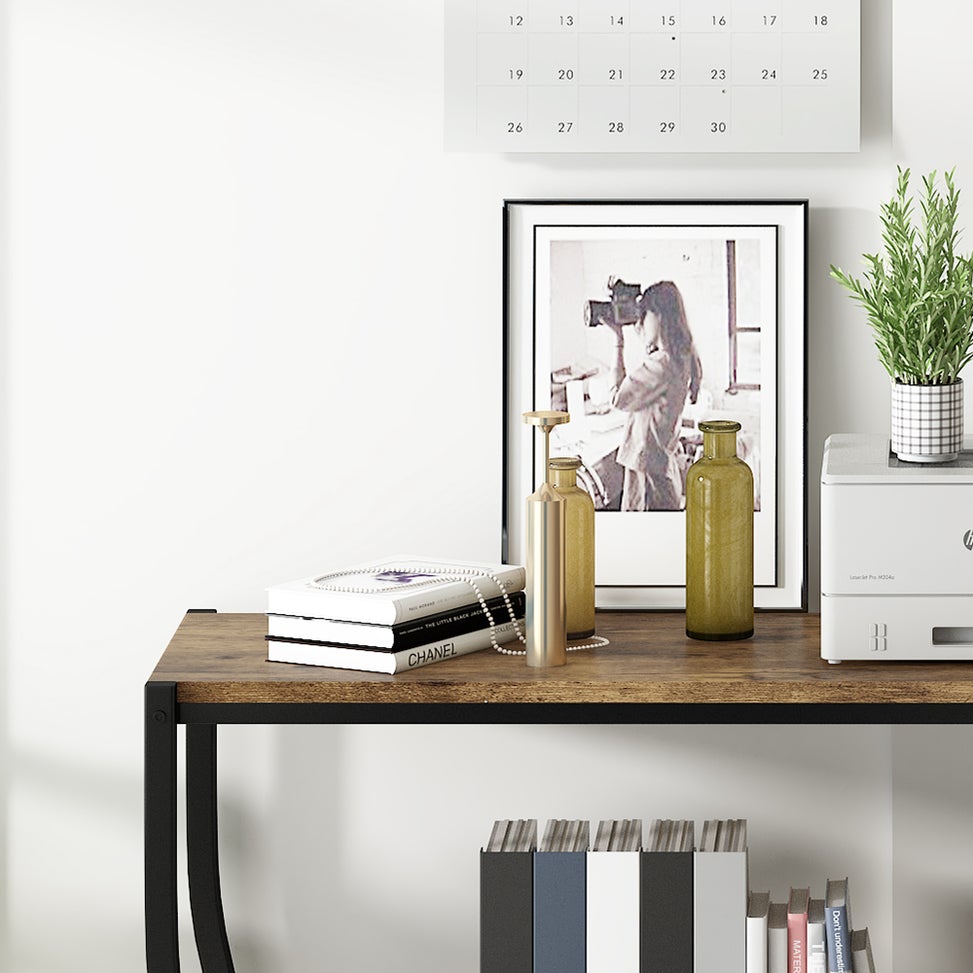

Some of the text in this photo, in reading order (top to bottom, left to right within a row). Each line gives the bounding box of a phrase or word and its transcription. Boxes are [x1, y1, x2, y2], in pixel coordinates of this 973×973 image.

[509, 15, 829, 27] 12 13 14 15 16 17 18
[509, 68, 828, 81] 19 20 21 22 23 24 25
[507, 121, 727, 133] 26 27 28 29 30
[425, 622, 436, 630] THE
[436, 617, 453, 626] LITTLE
[453, 613, 470, 622] BLACK
[408, 642, 458, 667] CHANEL
[832, 910, 842, 931] Don't
